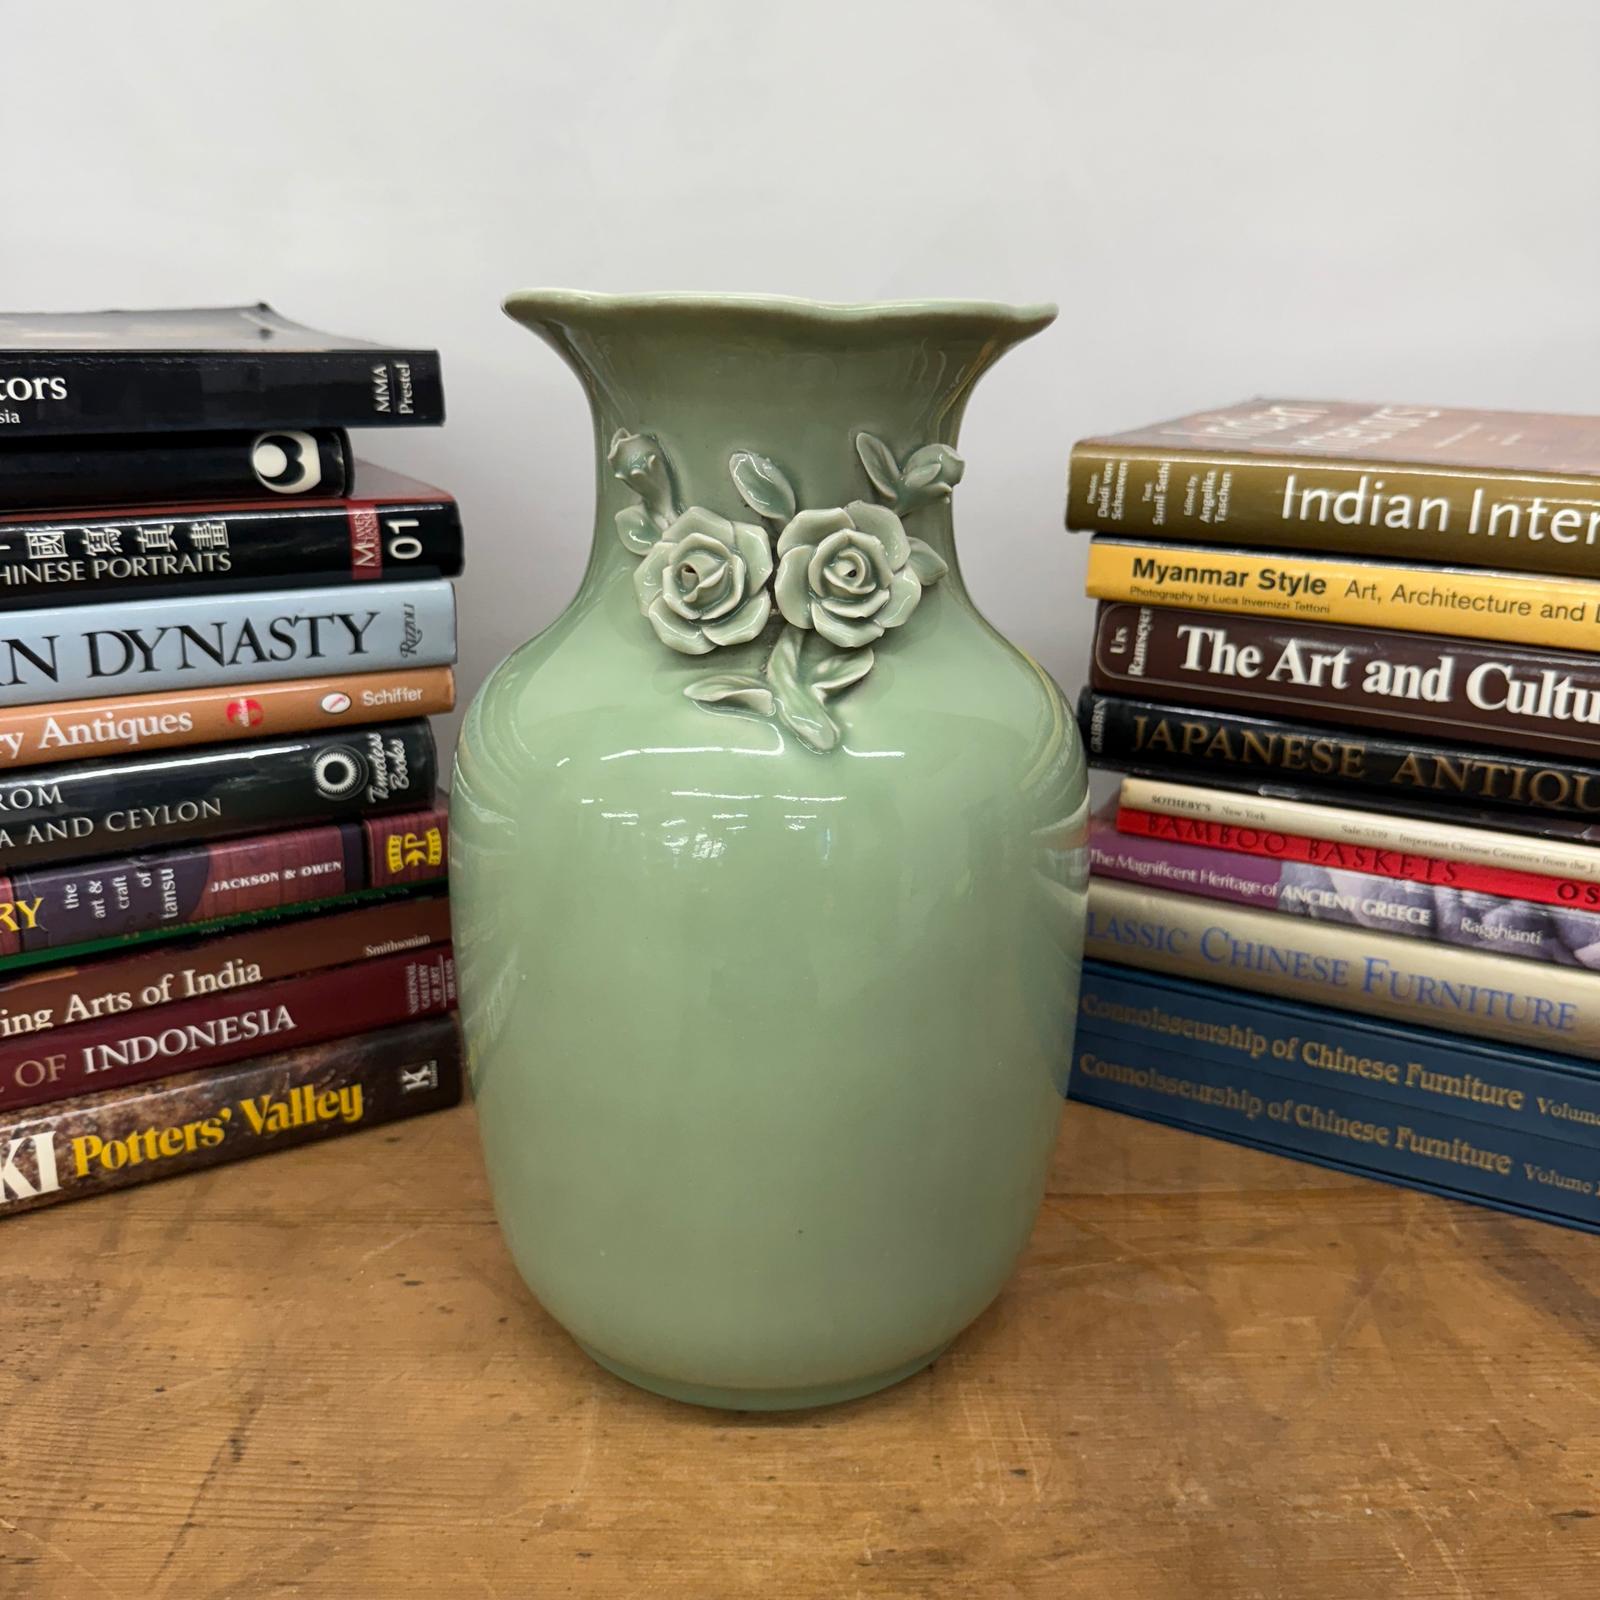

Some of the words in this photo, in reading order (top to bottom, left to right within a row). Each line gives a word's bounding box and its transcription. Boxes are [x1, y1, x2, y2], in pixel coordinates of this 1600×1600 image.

[373, 365, 391, 412] MMA
[396, 362, 414, 414] Prestel
[1103, 461, 1114, 484] von
[1155, 461, 1170, 493] Sethi
[1152, 494, 1166, 525] Sunil
[1199, 470, 1217, 523] Angelika
[1214, 471, 1232, 523] Taschen
[1281, 474, 1450, 531] Indian
[1467, 487, 1600, 545] Inter
[387, 518, 423, 560] 01
[94, 551, 232, 579] PORTRAITS
[1129, 586, 1193, 603] Photography
[1197, 592, 1210, 604] by
[1213, 594, 1238, 606] Luca
[1242, 596, 1290, 610] Invernizzi
[1132, 558, 1249, 588] Myanmar
[1257, 568, 1327, 597] Style
[1345, 580, 1383, 605] Art,
[1390, 582, 1532, 618] Architecture
[1540, 602, 1586, 623] and
[0, 635, 60, 687] N
[81, 611, 381, 678] DYNASTY
[1110, 625, 1129, 654] Urs
[1128, 605, 1153, 677] Ramseyer
[362, 686, 424, 706] Schiffer
[1176, 624, 1263, 679] The
[1266, 638, 1352, 690] Art
[1362, 654, 1455, 703] and
[1465, 661, 1600, 725] Cultu
[37, 711, 195, 750] Antiques
[1132, 714, 1367, 779] JAPANESE
[365, 731, 389, 803] Timeless
[385, 738, 410, 790] Books
[26, 815, 95, 845] AND
[105, 798, 223, 834] CEYLON
[1151, 795, 1212, 812] SOTHEBY'S
[1221, 805, 1241, 817] New
[1245, 809, 1266, 822] York
[1147, 814, 1288, 854] BAMBOO
[1306, 838, 1458, 883] BASKETS
[1399, 834, 1448, 851] Important
[1451, 840, 1490, 854] Chinese
[1492, 846, 1540, 864] Ceramics
[1542, 855, 1567, 868] from
[1570, 858, 1586, 871] the
[64, 883, 80, 910] the
[88, 880, 103, 894] &
[112, 875, 130, 910] craft
[136, 871, 152, 888] of
[161, 868, 179, 919] tansu
[211, 871, 280, 893] JACKSON
[284, 868, 297, 880] &
[301, 860, 342, 878] OWEN
[1116, 854, 1197, 882] Magnificent
[1200, 868, 1260, 895] Heritage
[1262, 882, 1279, 897] of
[1281, 885, 1357, 911] ANCIENT
[1360, 897, 1432, 926] GREECE
[1557, 882, 1600, 905] OS
[90, 897, 107, 919] art
[1460, 917, 1543, 946] Ragghianti
[365, 934, 431, 957] Smithsonian
[0, 1008, 54, 1037] ing
[64, 989, 134, 1024] Arts
[142, 974, 175, 1004] of
[183, 958, 263, 996] India
[1201, 925, 1350, 988] CHINESE
[1361, 956, 1579, 1032] FURNITURE
[14, 1053, 68, 1087] OF
[82, 1003, 298, 1075] INDONESIA
[1080, 993, 1268, 1059] Connoisseurship
[1272, 1037, 1299, 1061] of
[1302, 1041, 1399, 1085] Chinese
[1405, 1062, 1526, 1111] Furniture
[240, 1080, 365, 1137] Valley
[1079, 1052, 1263, 1118] Connoisseurship
[1268, 1099, 1295, 1122] of
[1295, 1102, 1391, 1147] Chinese
[1395, 1125, 1514, 1176] Furniture
[1523, 1162, 1593, 1194] Volume
